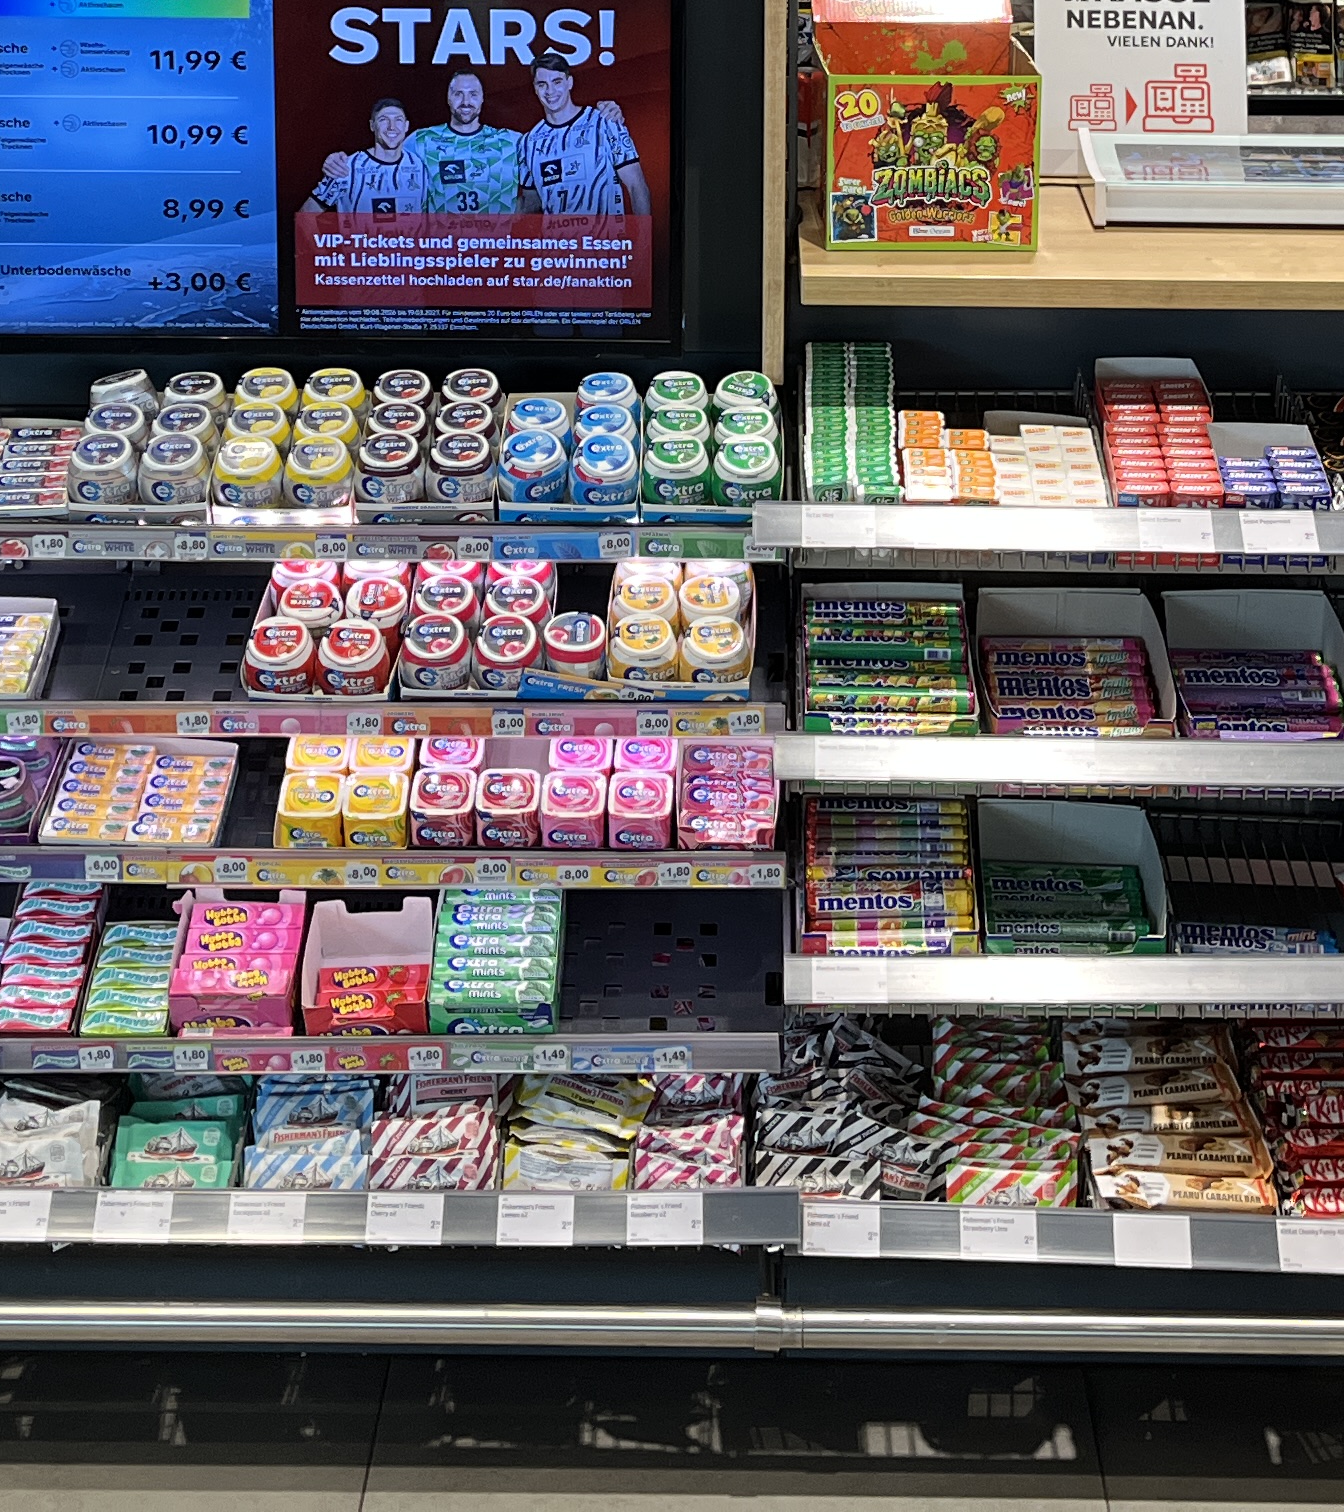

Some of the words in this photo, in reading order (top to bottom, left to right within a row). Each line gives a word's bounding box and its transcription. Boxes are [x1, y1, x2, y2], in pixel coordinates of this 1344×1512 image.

[1066, 10, 1203, 30] NEBENAN.
[328, 6, 616, 67] STARS!
[1107, 36, 1161, 47] VIELEN
[1166, 36, 1214, 48] DANK!
[149, 50, 221, 74] 11,99
[229, 51, 247, 71] €
[836, 91, 880, 120] 20
[146, 125, 223, 149] 10,99
[231, 126, 249, 145] €
[162, 199, 224, 223] 8,99
[233, 200, 250, 219] €
[456, 192, 480, 212] 33
[314, 234, 414, 249] VIP-Tickets
[419, 235, 453, 250] und
[457, 236, 578, 254] gemeinsames
[582, 236, 632, 251] Essen
[315, 253, 346, 267] mit
[350, 253, 499, 271] Lieblingsspieler
[503, 256, 526, 268] zu
[148, 273, 226, 296] +3,00
[234, 273, 251, 292] €
[315, 274, 405, 286] Kassenzettel
[409, 274, 483, 287] hochladen
[487, 275, 509, 287] auf
[513, 275, 632, 289] star.de/fanaktion
[994, 650, 1087, 667] mentos
[1184, 668, 1280, 685] mentos
[989, 877, 1084, 893] mentos
[817, 894, 914, 912] mentos
[471, 967, 506, 977] mints
[1166, 1152, 1198, 1161] PEANUT
[1199, 1153, 1235, 1163] CARAMEL
[1237, 1154, 1253, 1163] BAR
[1173, 1191, 1205, 1201] PEANUT
[1207, 1191, 1243, 1202] CARAMEL
[1245, 1193, 1261, 1203] BAR
